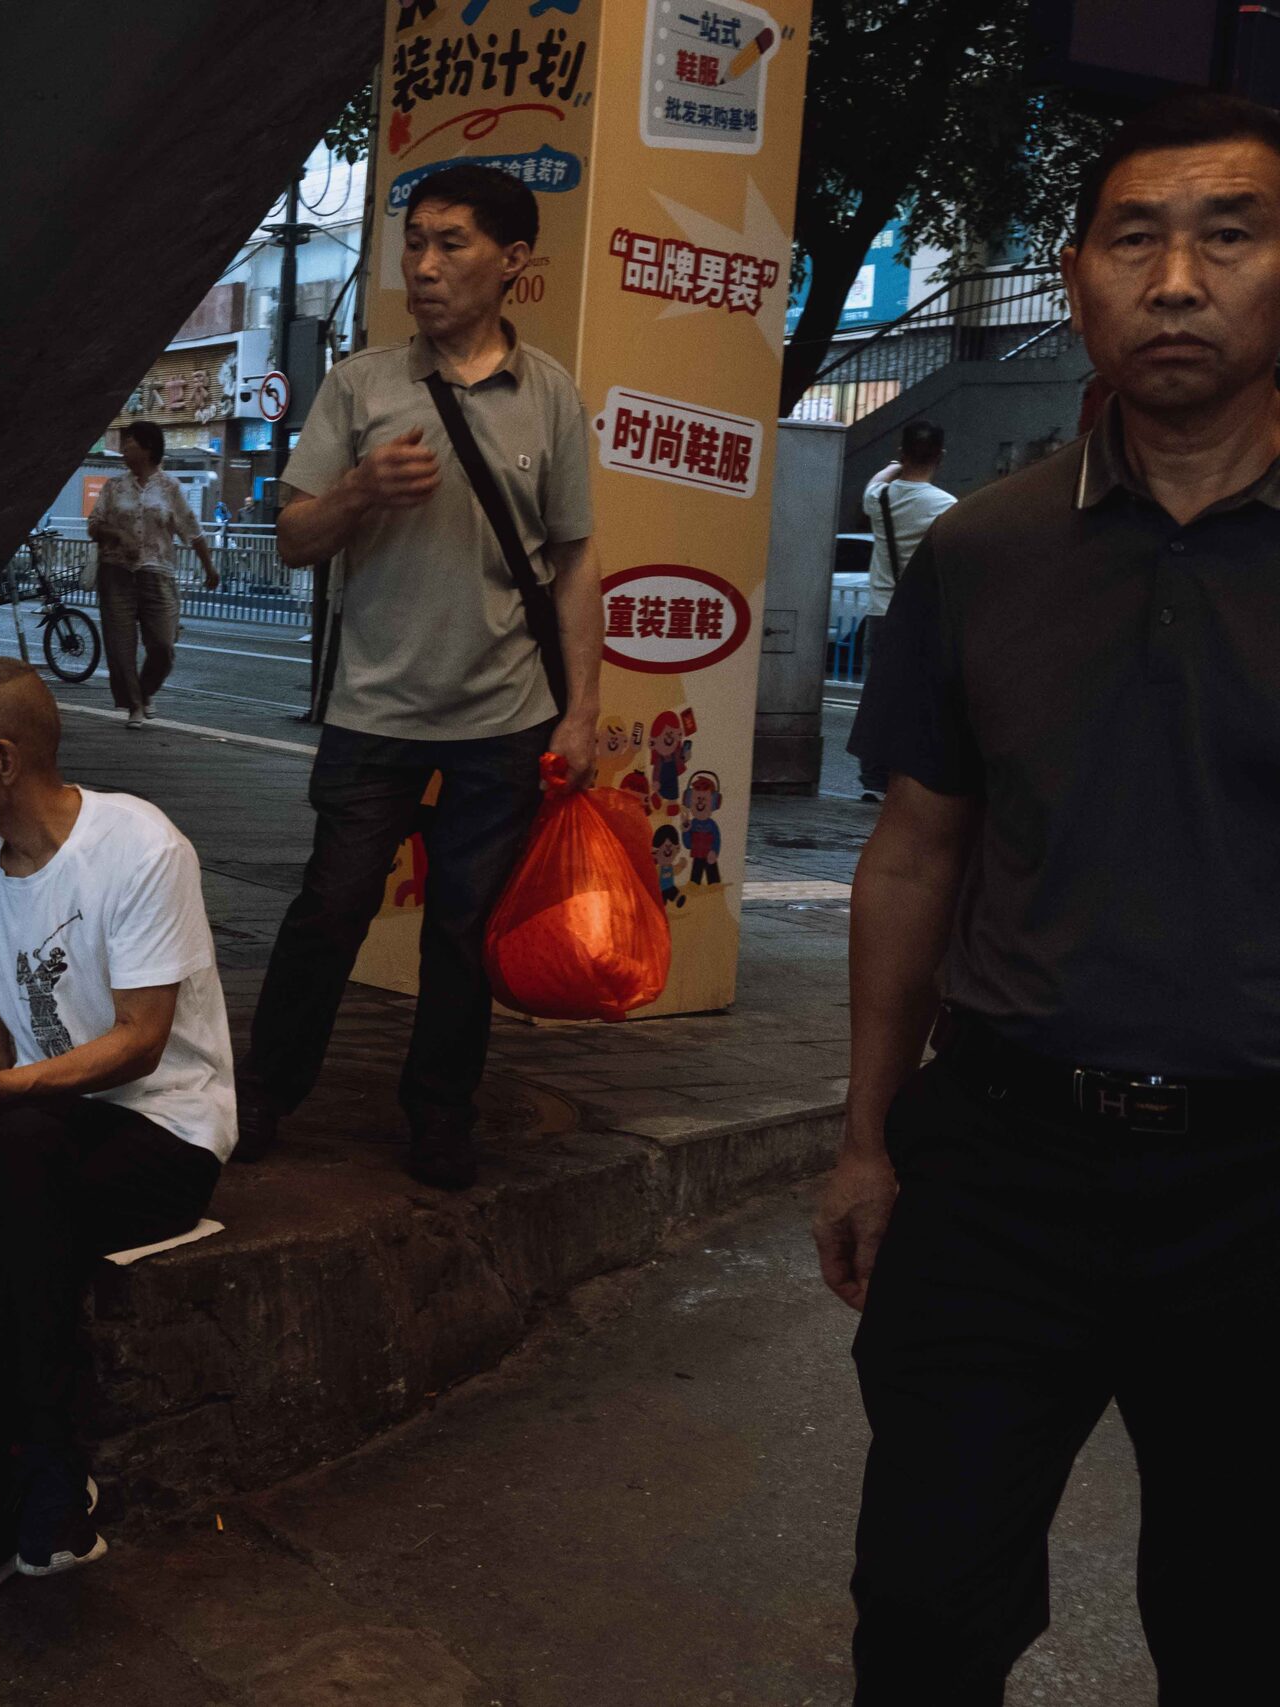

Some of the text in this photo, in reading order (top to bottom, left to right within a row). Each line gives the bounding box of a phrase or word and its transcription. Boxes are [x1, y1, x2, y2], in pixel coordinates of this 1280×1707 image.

[680, 11, 741, 47] 一站式
[676, 49, 719, 87] 鞋服
[665, 96, 758, 131] 批发采购基地
[613, 407, 752, 484] 时尚鞋服
[606, 595, 723, 639] 童装童鞋
